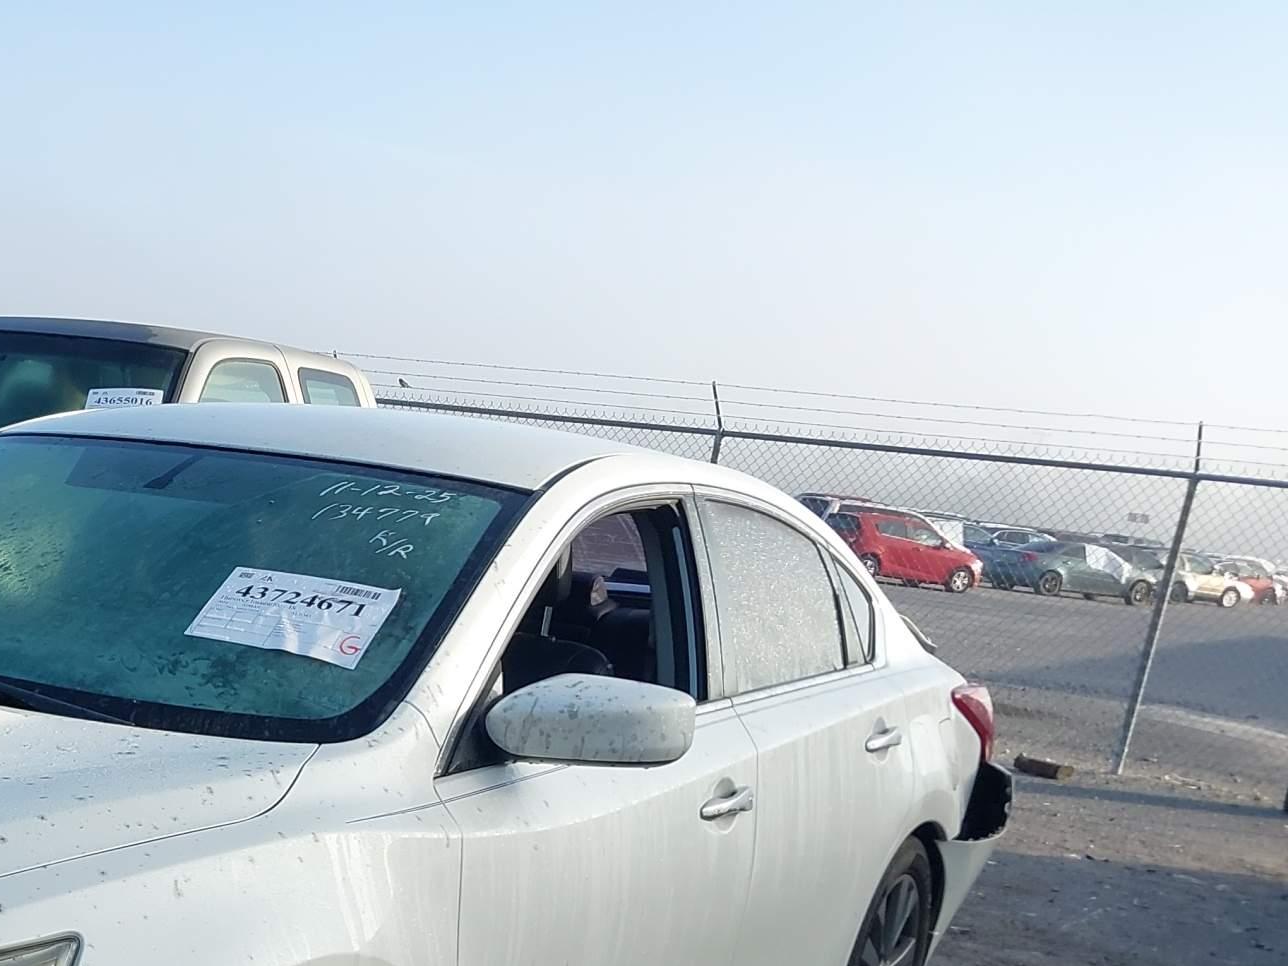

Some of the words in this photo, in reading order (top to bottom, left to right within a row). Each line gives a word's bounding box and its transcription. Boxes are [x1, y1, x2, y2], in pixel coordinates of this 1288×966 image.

[94, 396, 153, 406] 43655016
[319, 481, 457, 503] 11-12-25
[234, 584, 366, 617] 43724671
[339, 635, 361, 656] G
